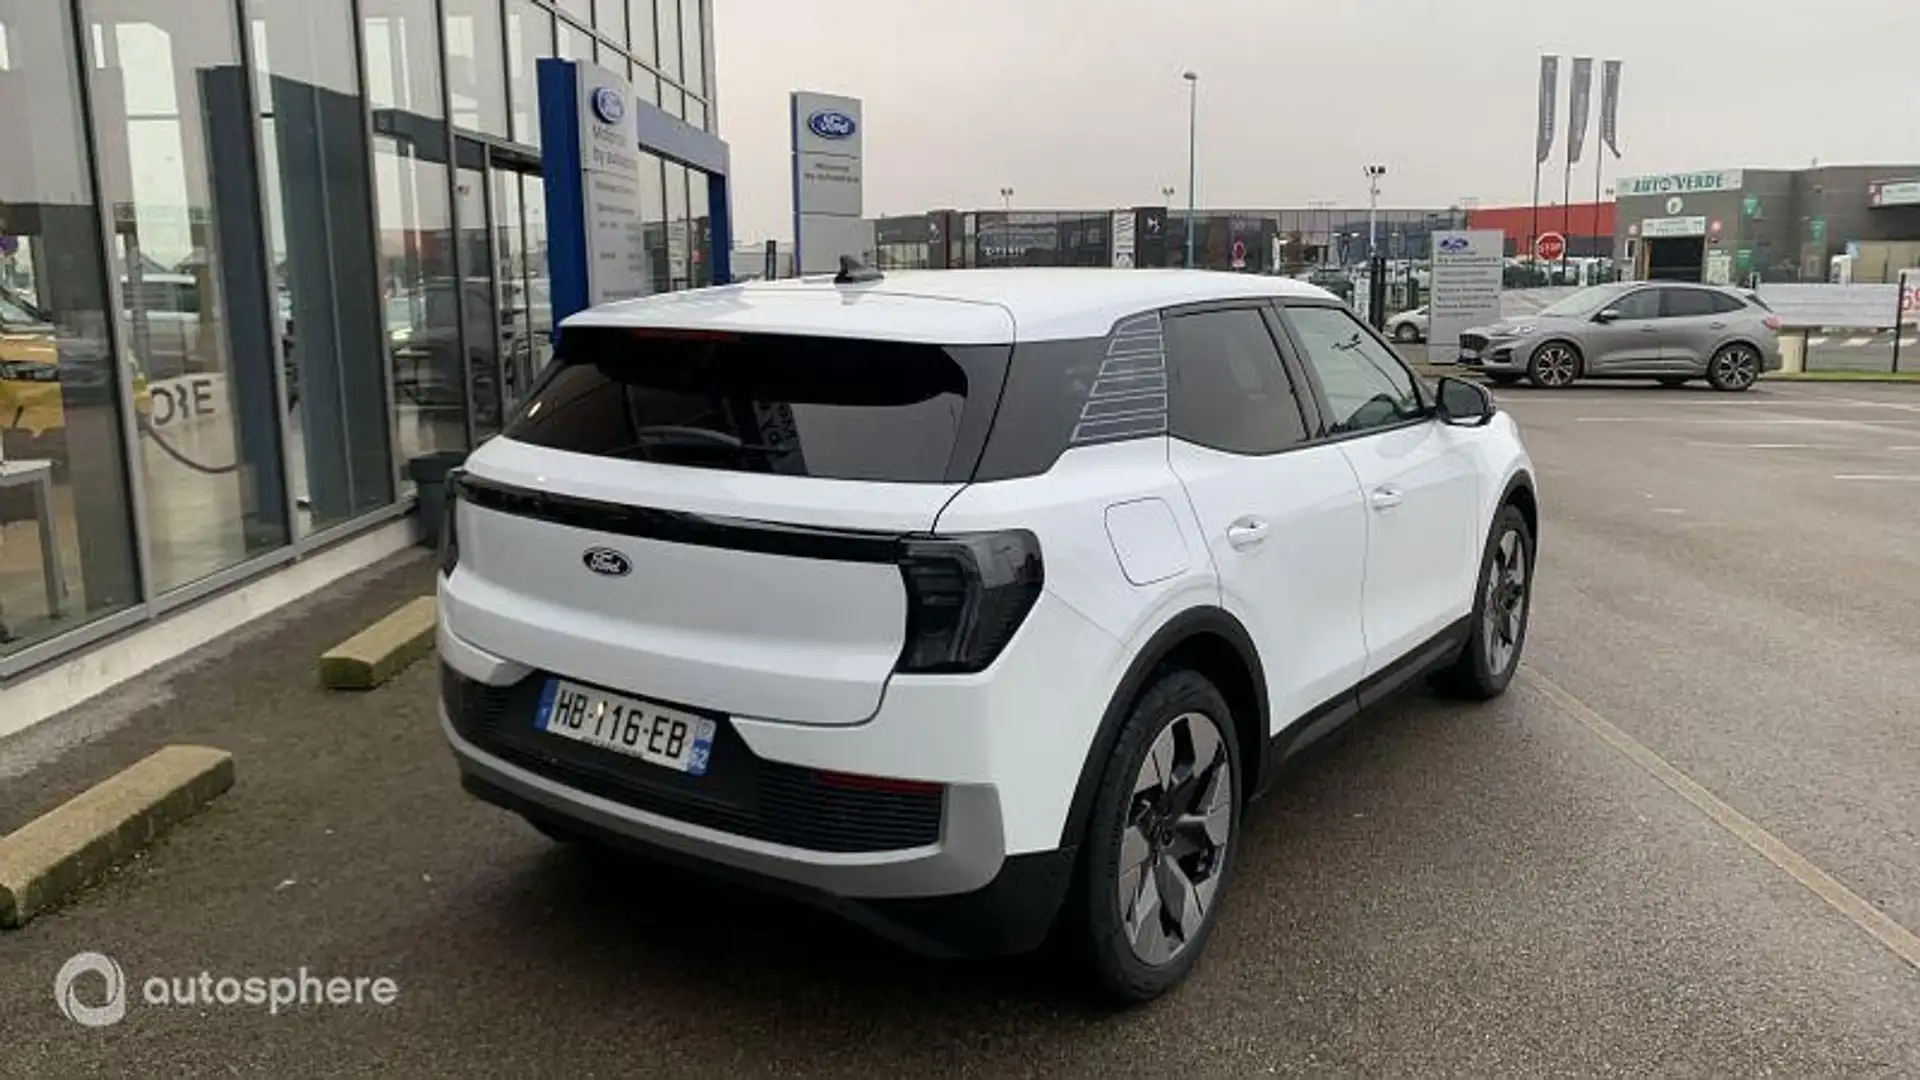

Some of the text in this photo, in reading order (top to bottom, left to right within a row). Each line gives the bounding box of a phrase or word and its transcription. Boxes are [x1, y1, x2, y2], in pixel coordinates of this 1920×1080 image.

[1670, 175, 1725, 190] VERDE
[1540, 241, 1561, 256] STOP
[554, 690, 688, 759] HB-116-EB
